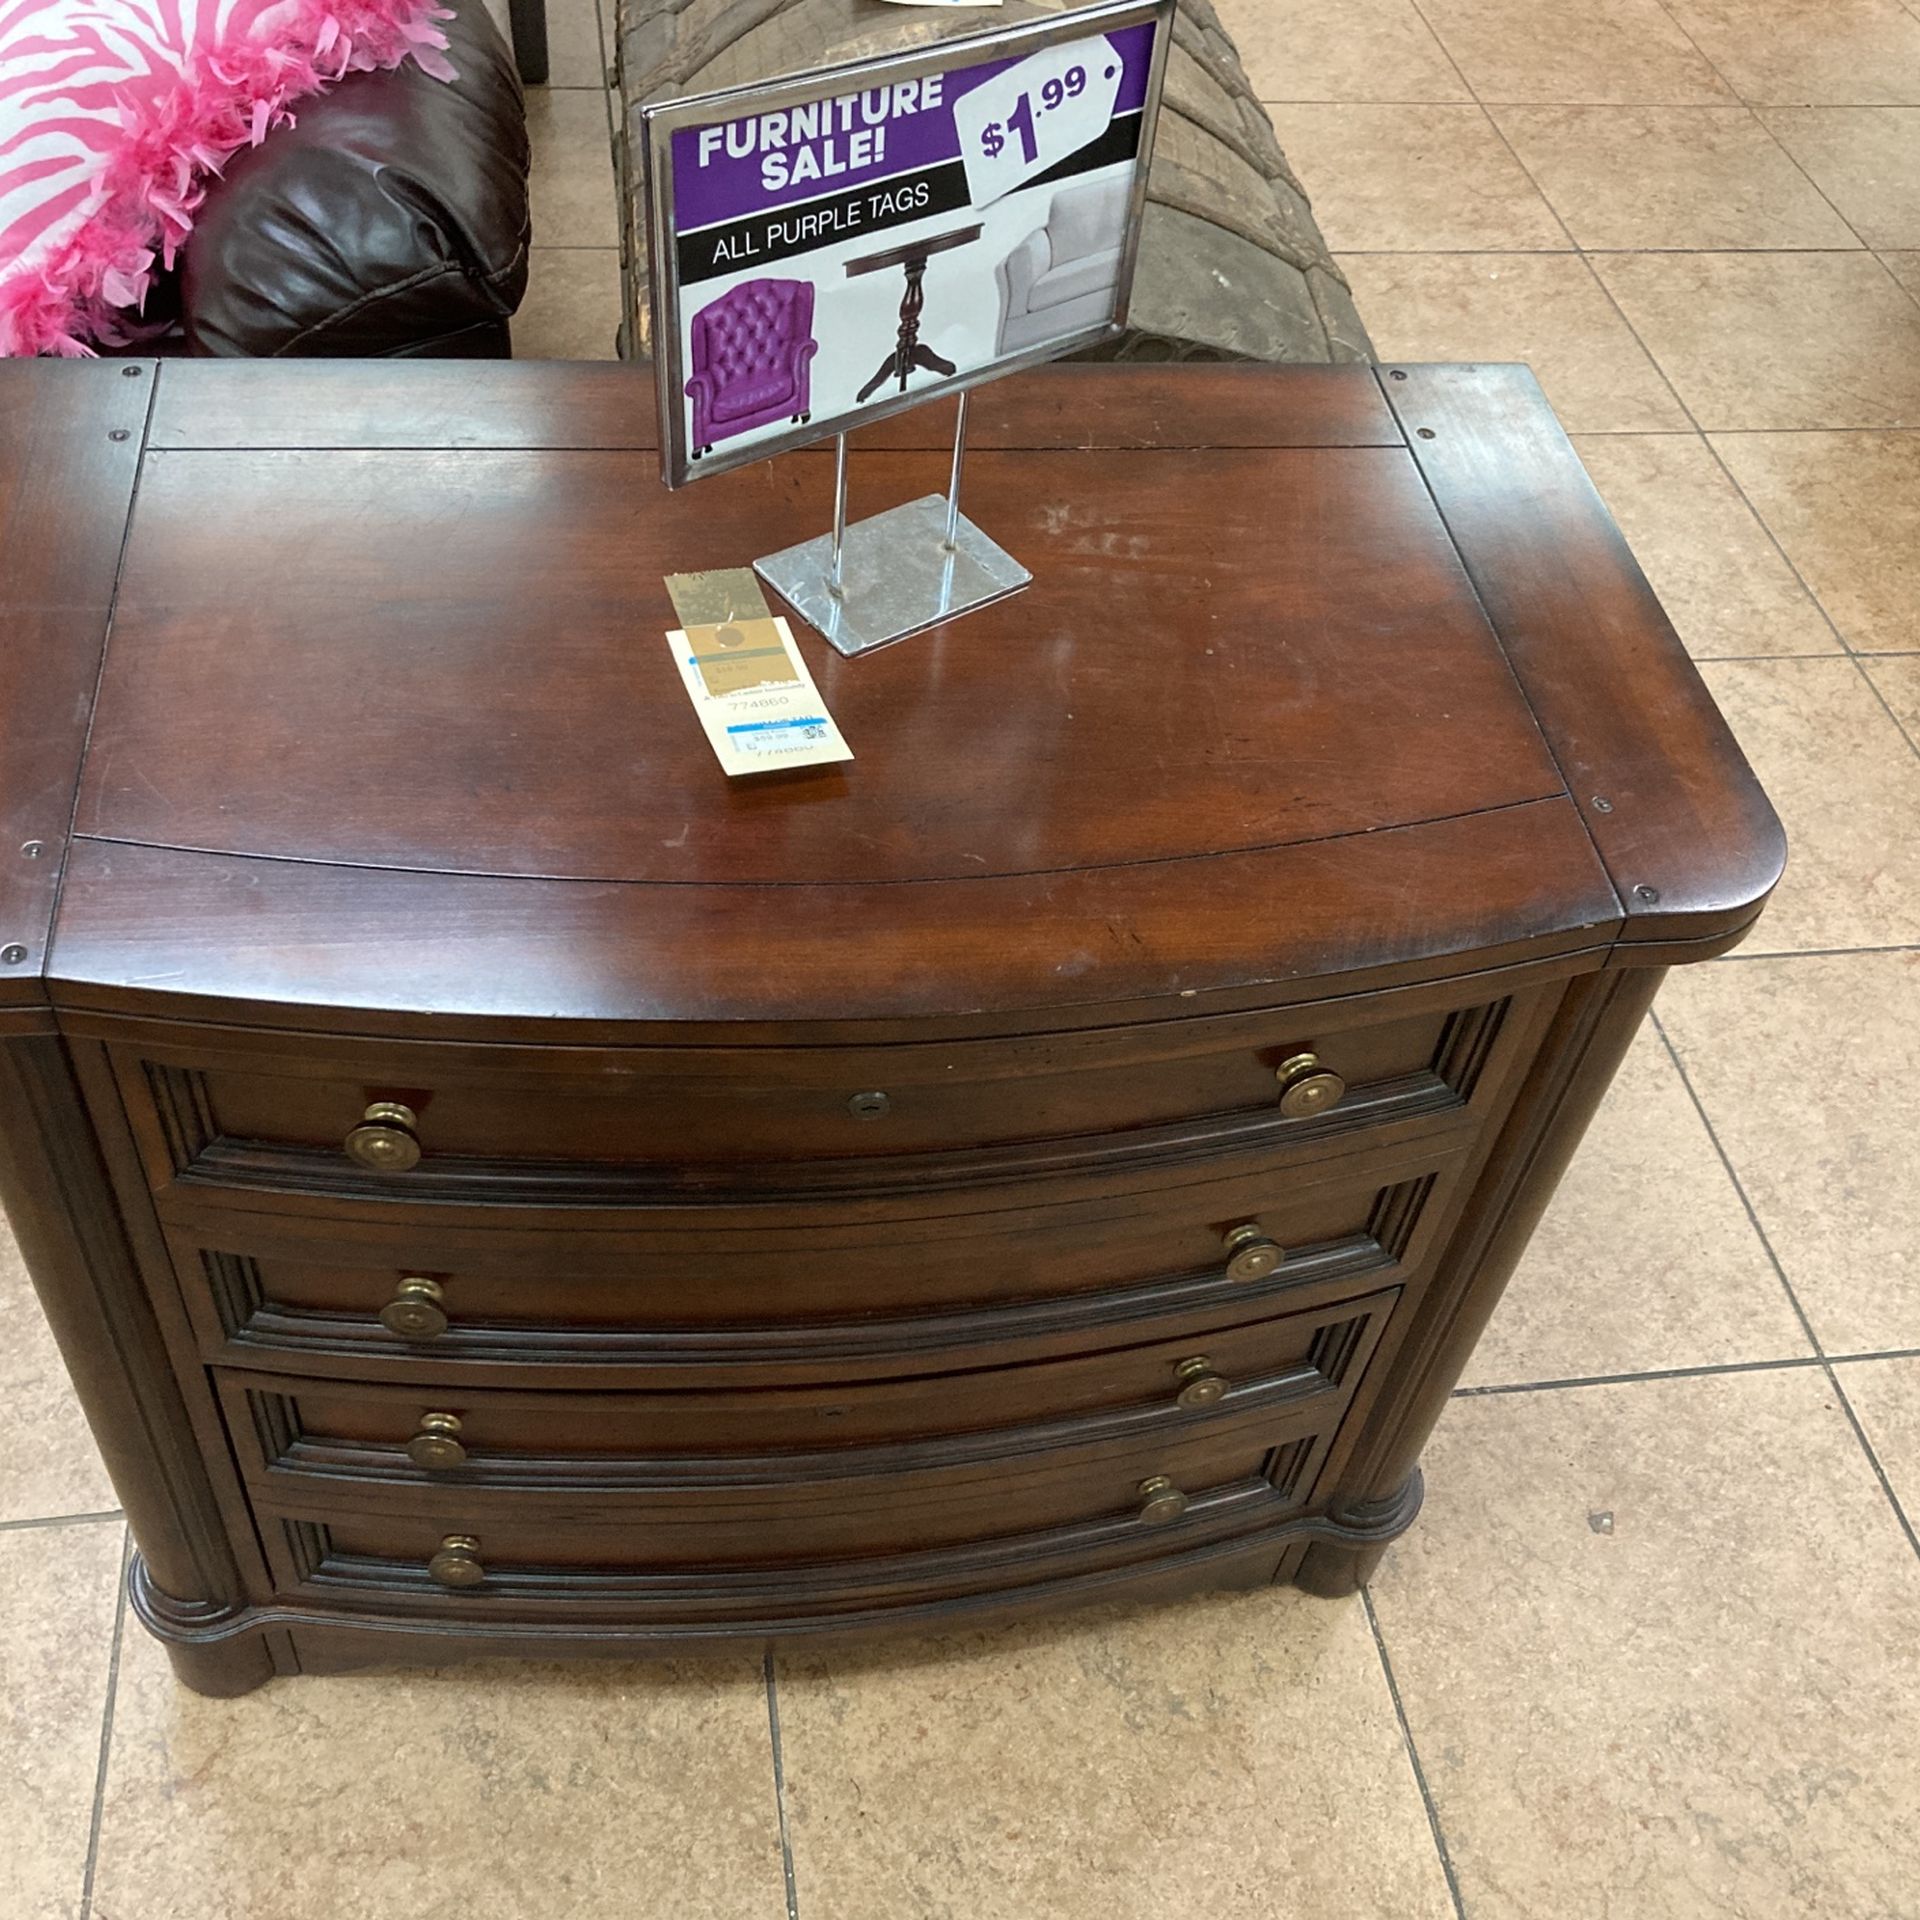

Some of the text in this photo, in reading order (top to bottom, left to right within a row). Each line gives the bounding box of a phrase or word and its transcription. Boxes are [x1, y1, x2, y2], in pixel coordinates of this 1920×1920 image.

[699, 73, 944, 168] FURNITURE
[761, 126, 885, 191] SALE!
[712, 182, 929, 264] ALL PURPLE TAGS
